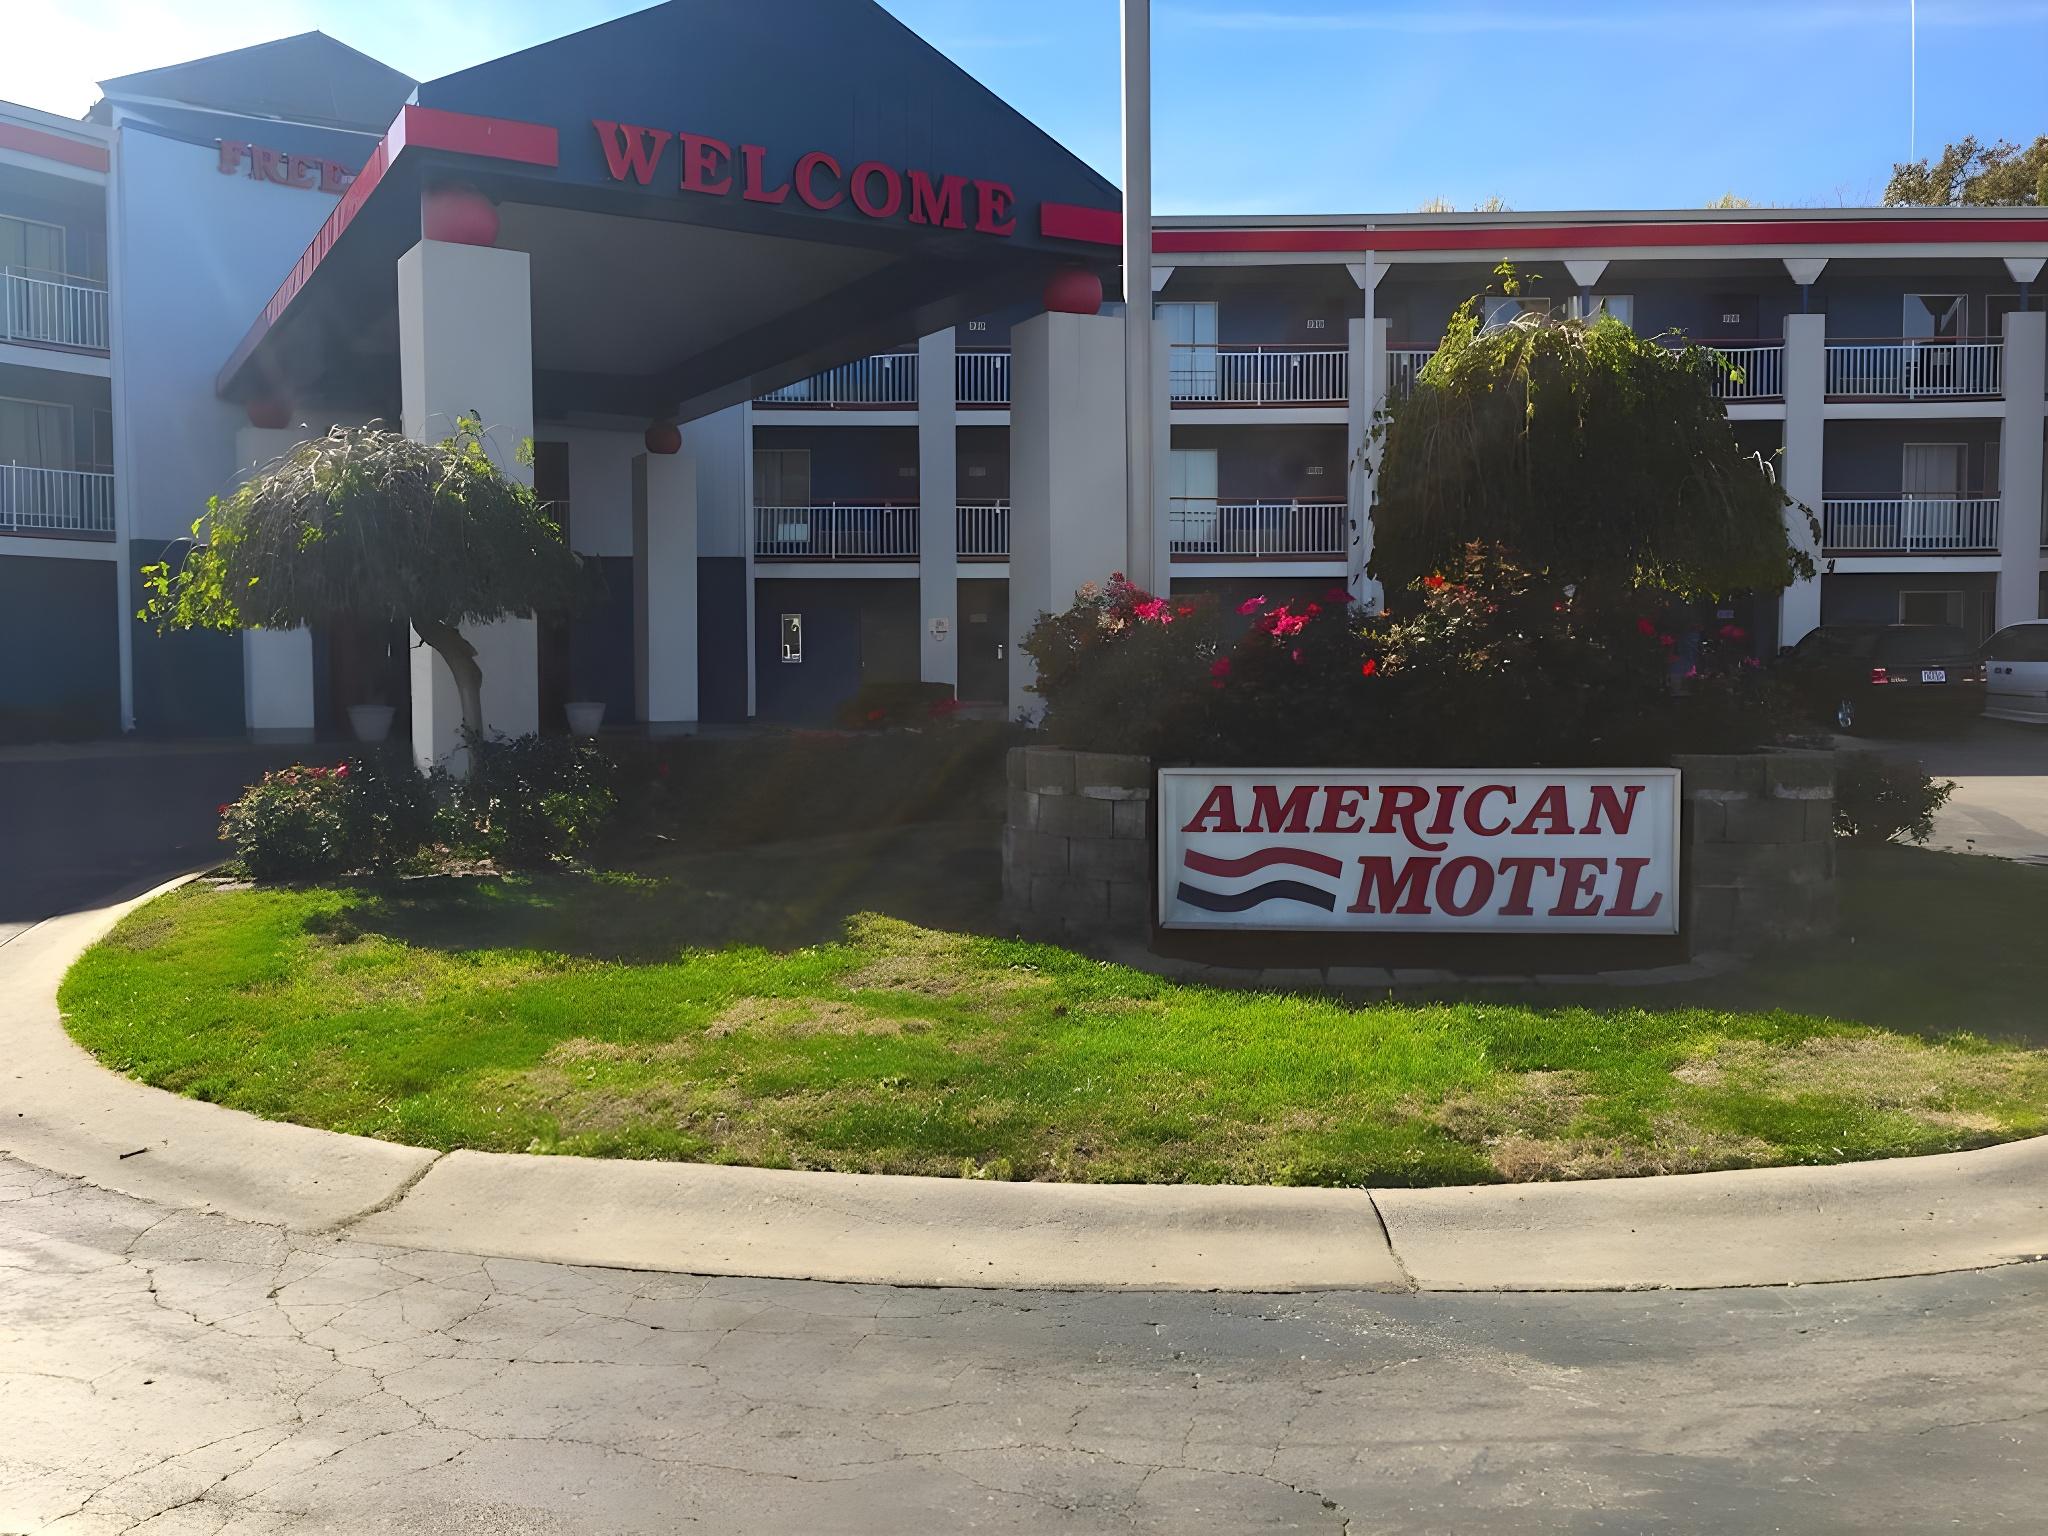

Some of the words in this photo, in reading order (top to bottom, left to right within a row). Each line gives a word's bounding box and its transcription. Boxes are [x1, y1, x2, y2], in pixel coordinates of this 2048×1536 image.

[217, 140, 357, 195] FREE
[592, 119, 1017, 236] WELCOME
[1181, 784, 1646, 852] AMERICAN
[1346, 855, 1664, 917] MOTEL
